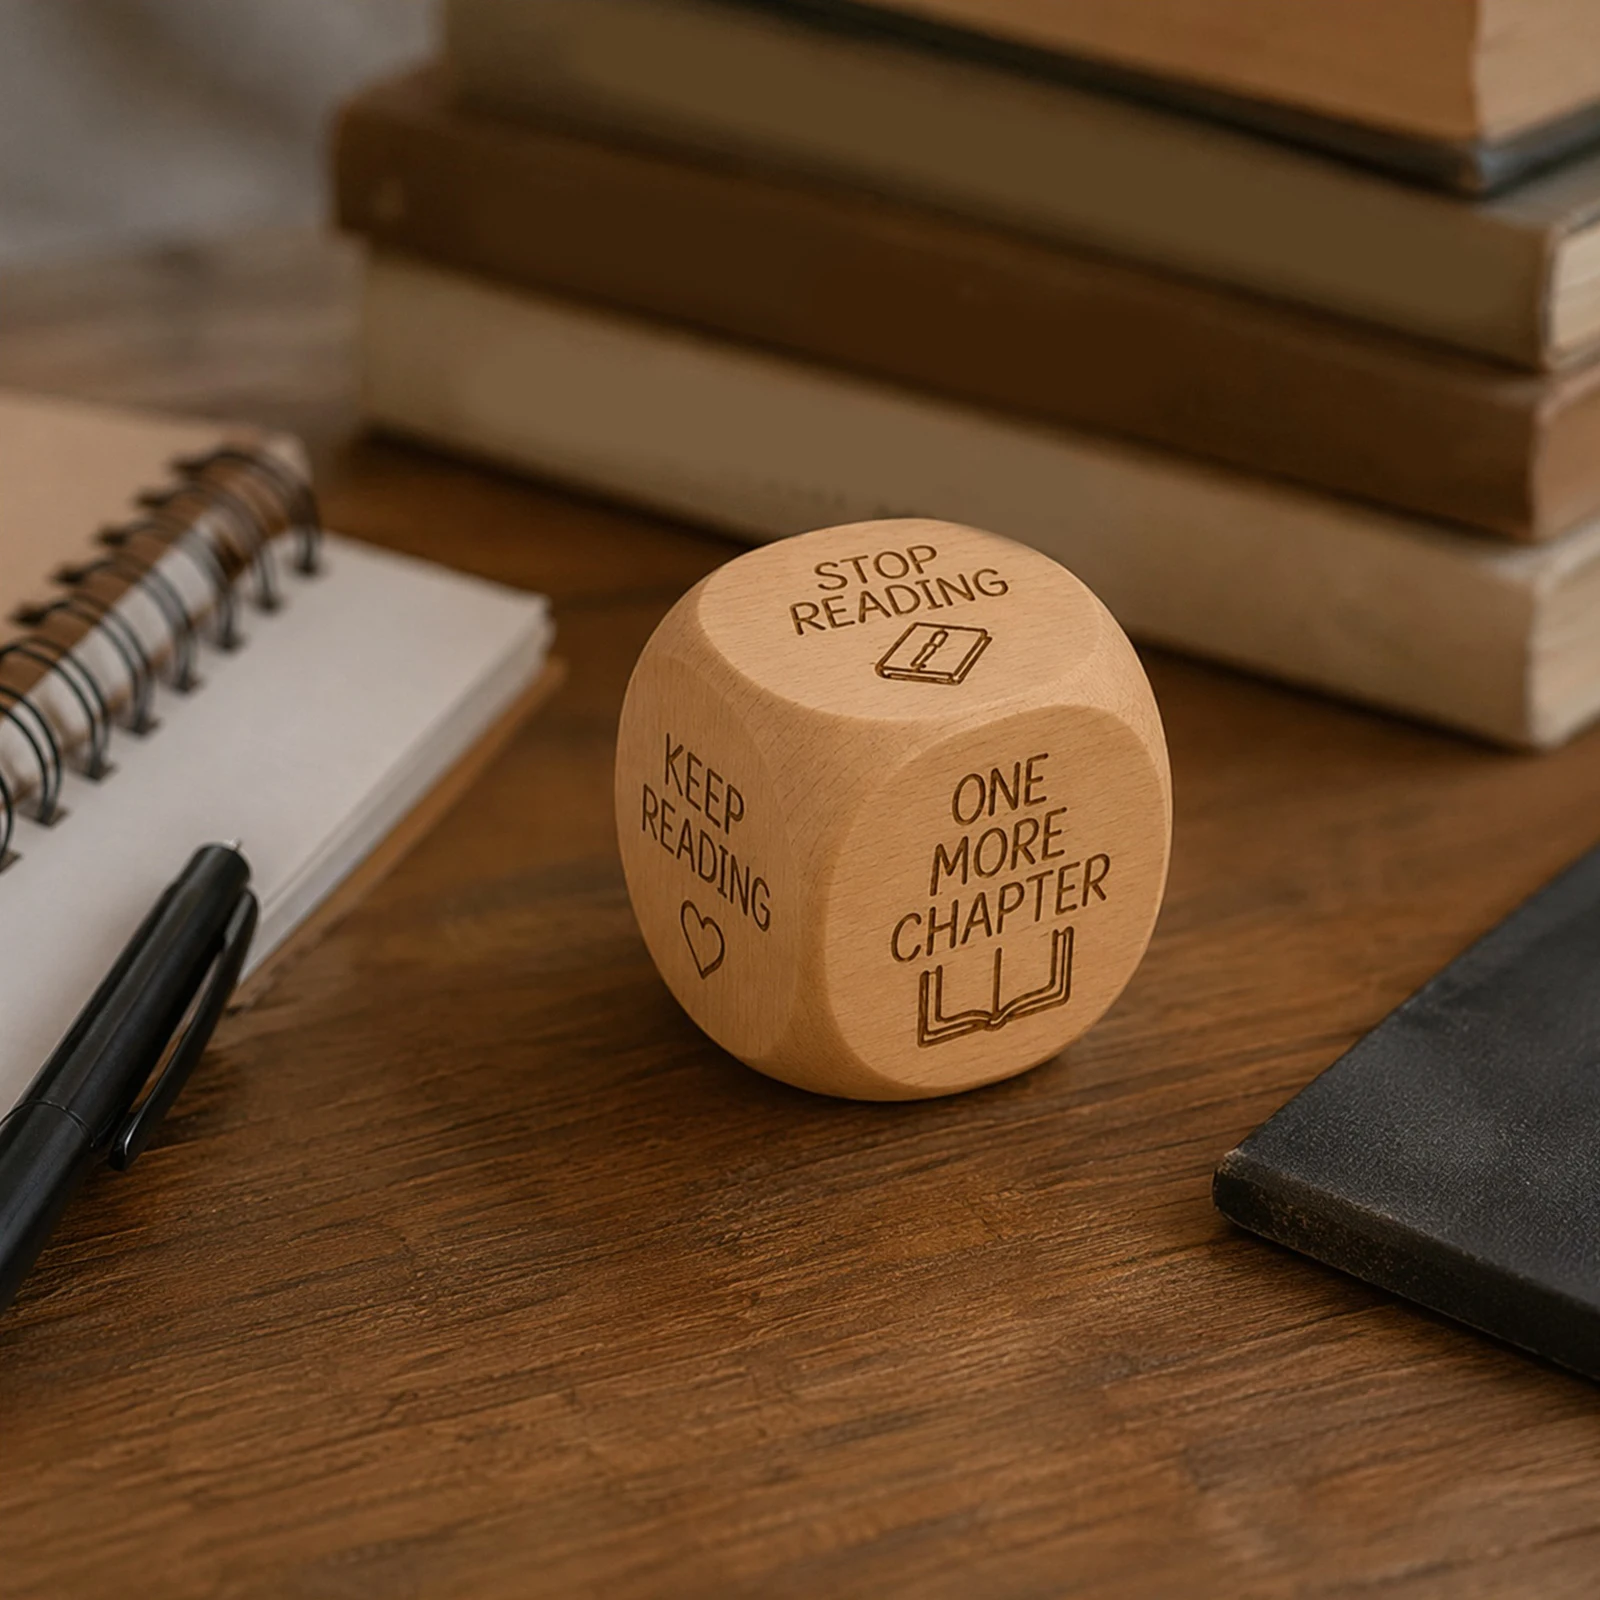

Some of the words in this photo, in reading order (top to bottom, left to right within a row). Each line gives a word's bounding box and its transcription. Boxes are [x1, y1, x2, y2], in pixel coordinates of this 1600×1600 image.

[790, 568, 1009, 635] READING
[814, 545, 937, 591] STOP
[665, 734, 745, 834] KEEP
[952, 754, 1049, 826] ONE
[642, 785, 771, 932] READING
[930, 807, 1067, 896] MORE
[891, 854, 1111, 962] CHAPTER
